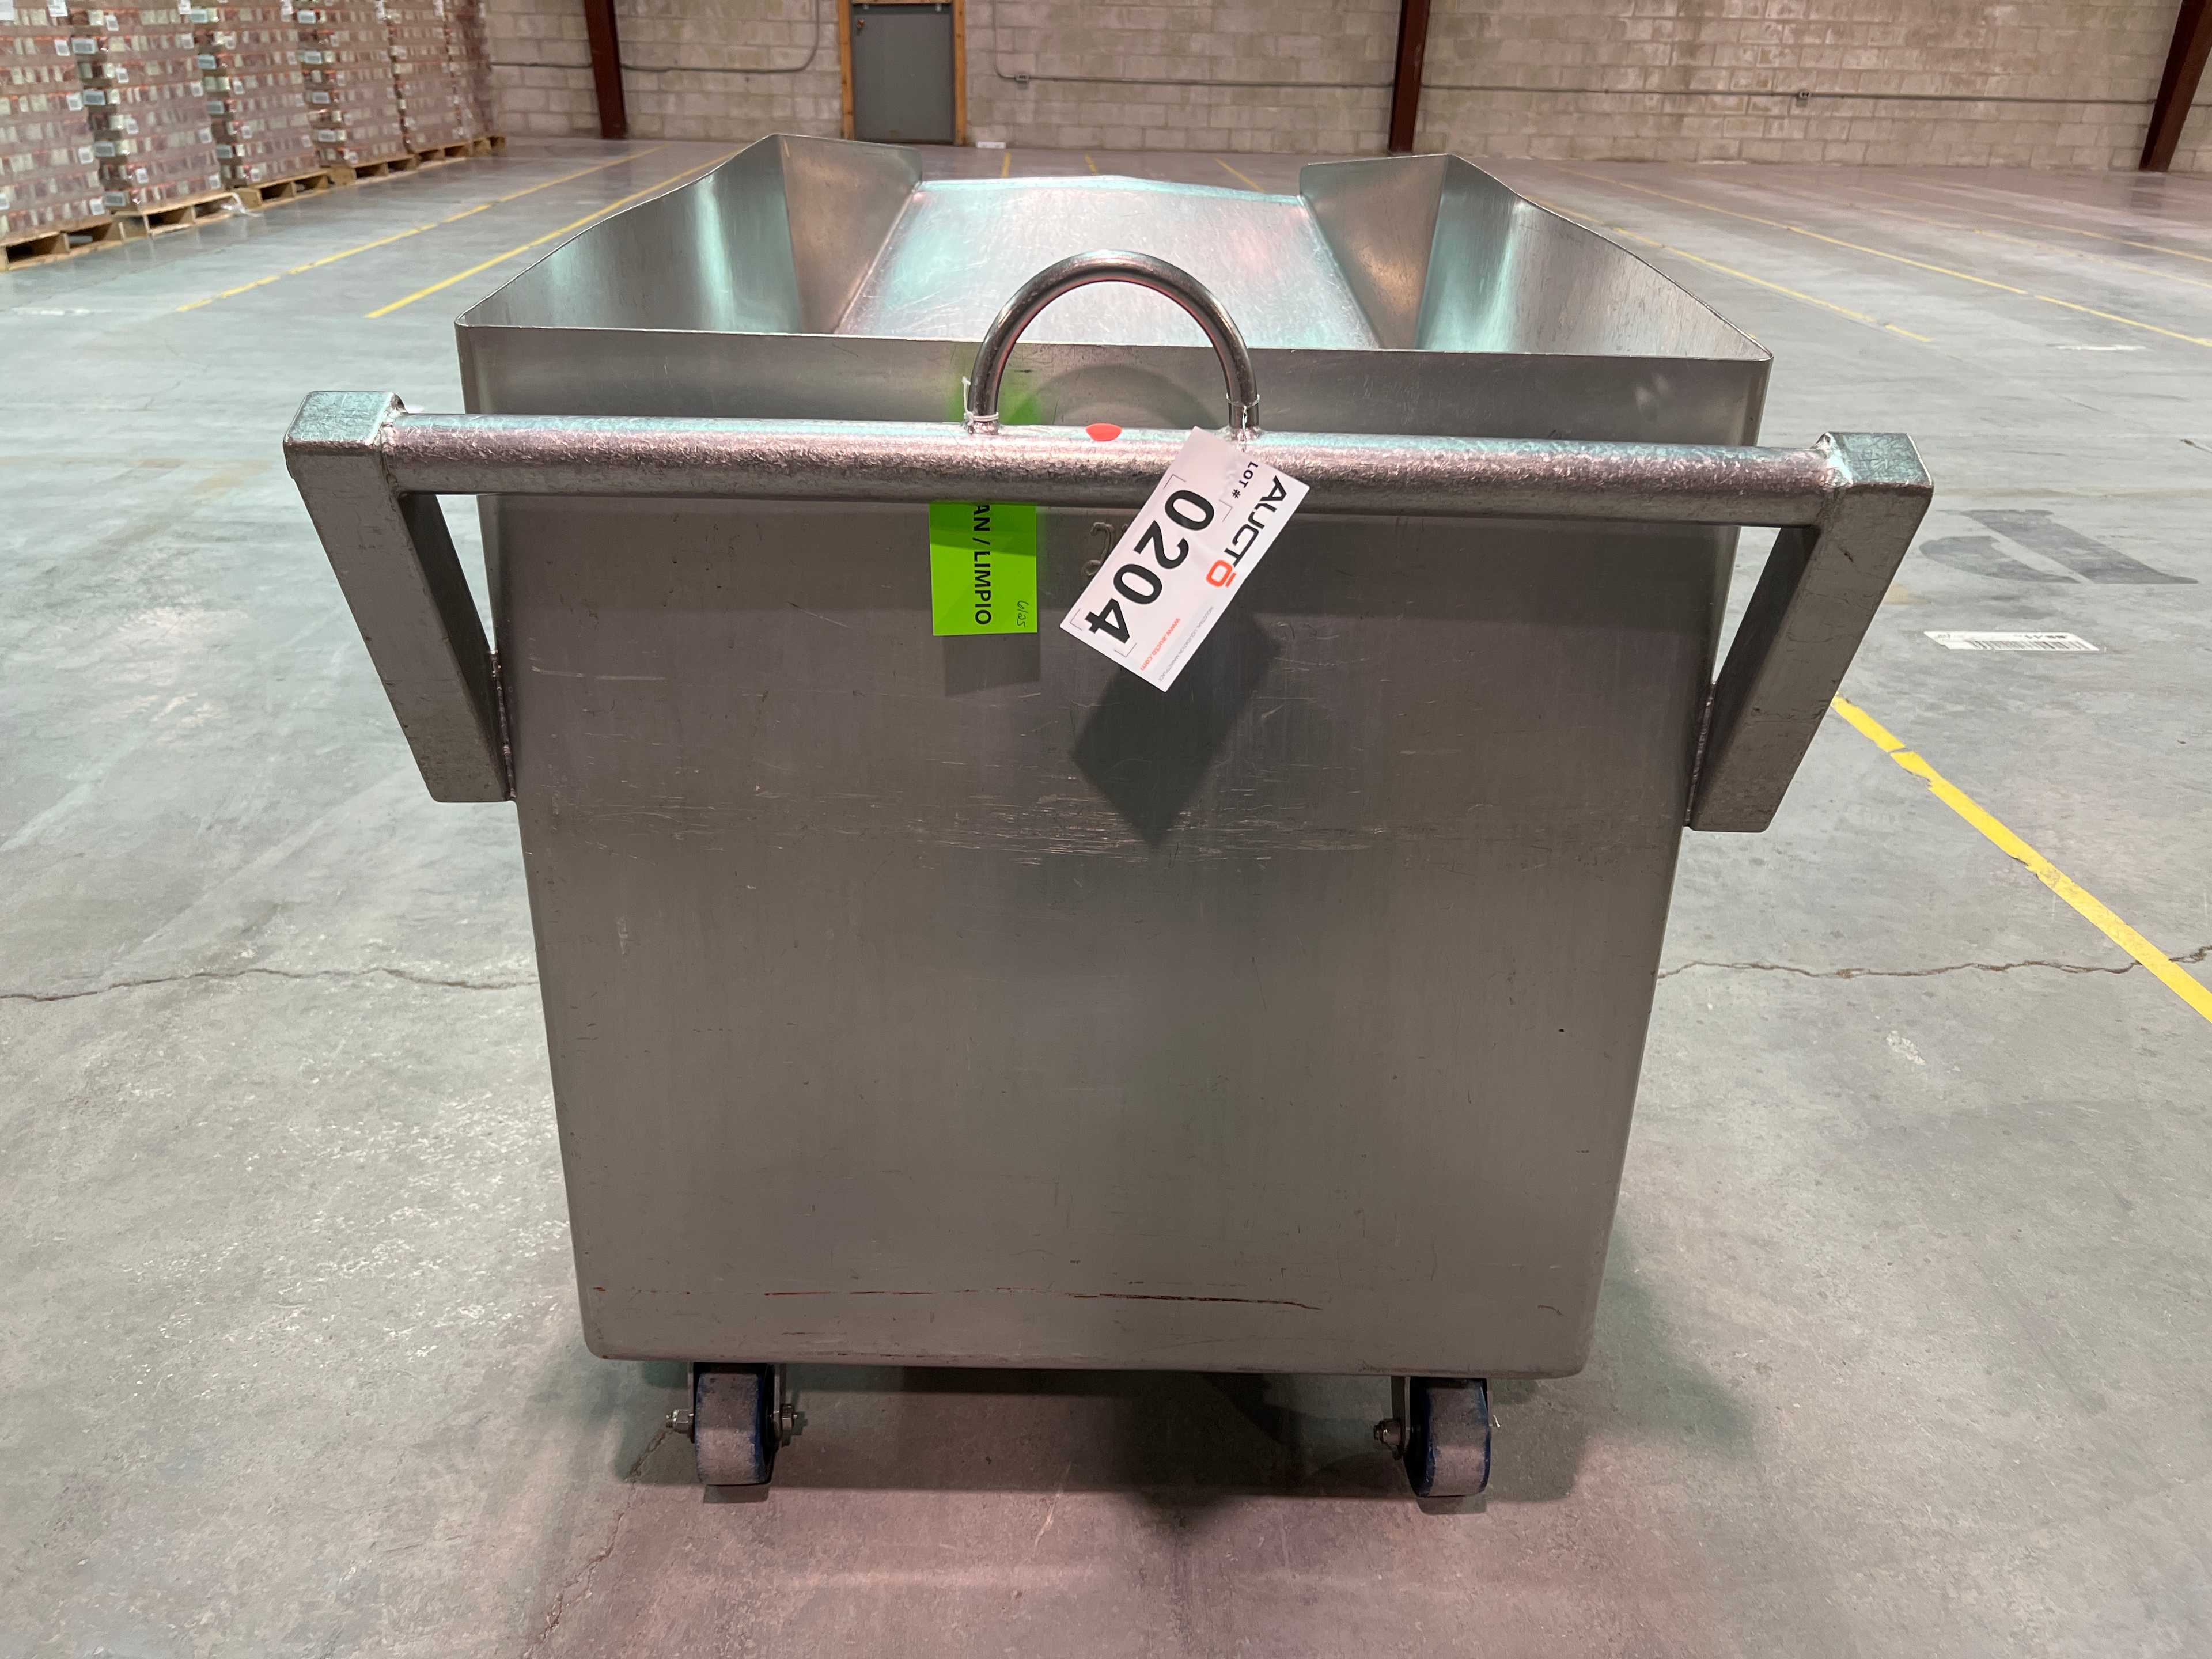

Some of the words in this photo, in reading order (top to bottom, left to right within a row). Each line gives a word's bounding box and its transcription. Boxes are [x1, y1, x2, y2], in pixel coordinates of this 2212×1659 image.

[1231, 488, 1241, 499] #
[1238, 461, 1259, 488] LOT
[974, 551, 992, 625] LIMPIO
[1085, 490, 1214, 644] 0204
[1140, 618, 1180, 671] www.aucto.com
